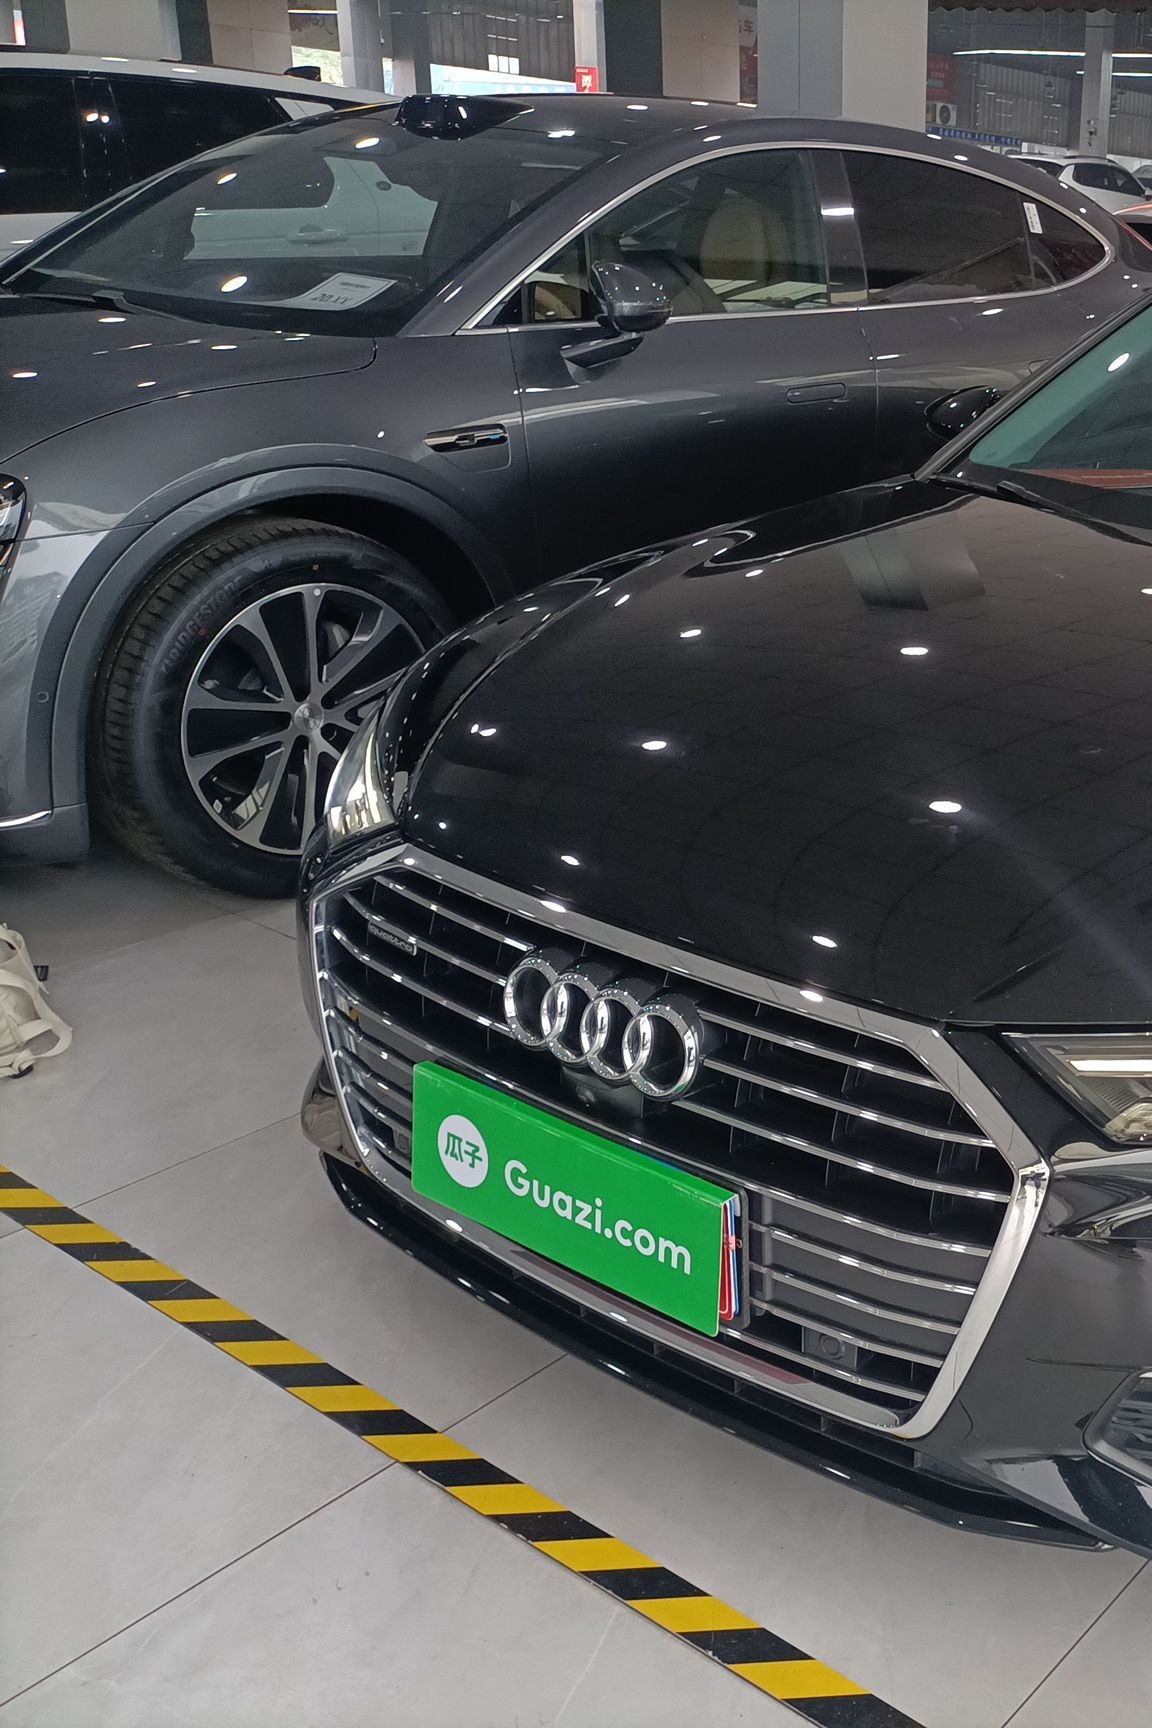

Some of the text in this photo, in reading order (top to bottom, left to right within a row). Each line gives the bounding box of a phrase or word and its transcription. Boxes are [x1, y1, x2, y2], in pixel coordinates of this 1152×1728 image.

[369, 924, 413, 952] quattro
[444, 1131, 483, 1169] 瓜子
[504, 1159, 692, 1276] Guazi.com
